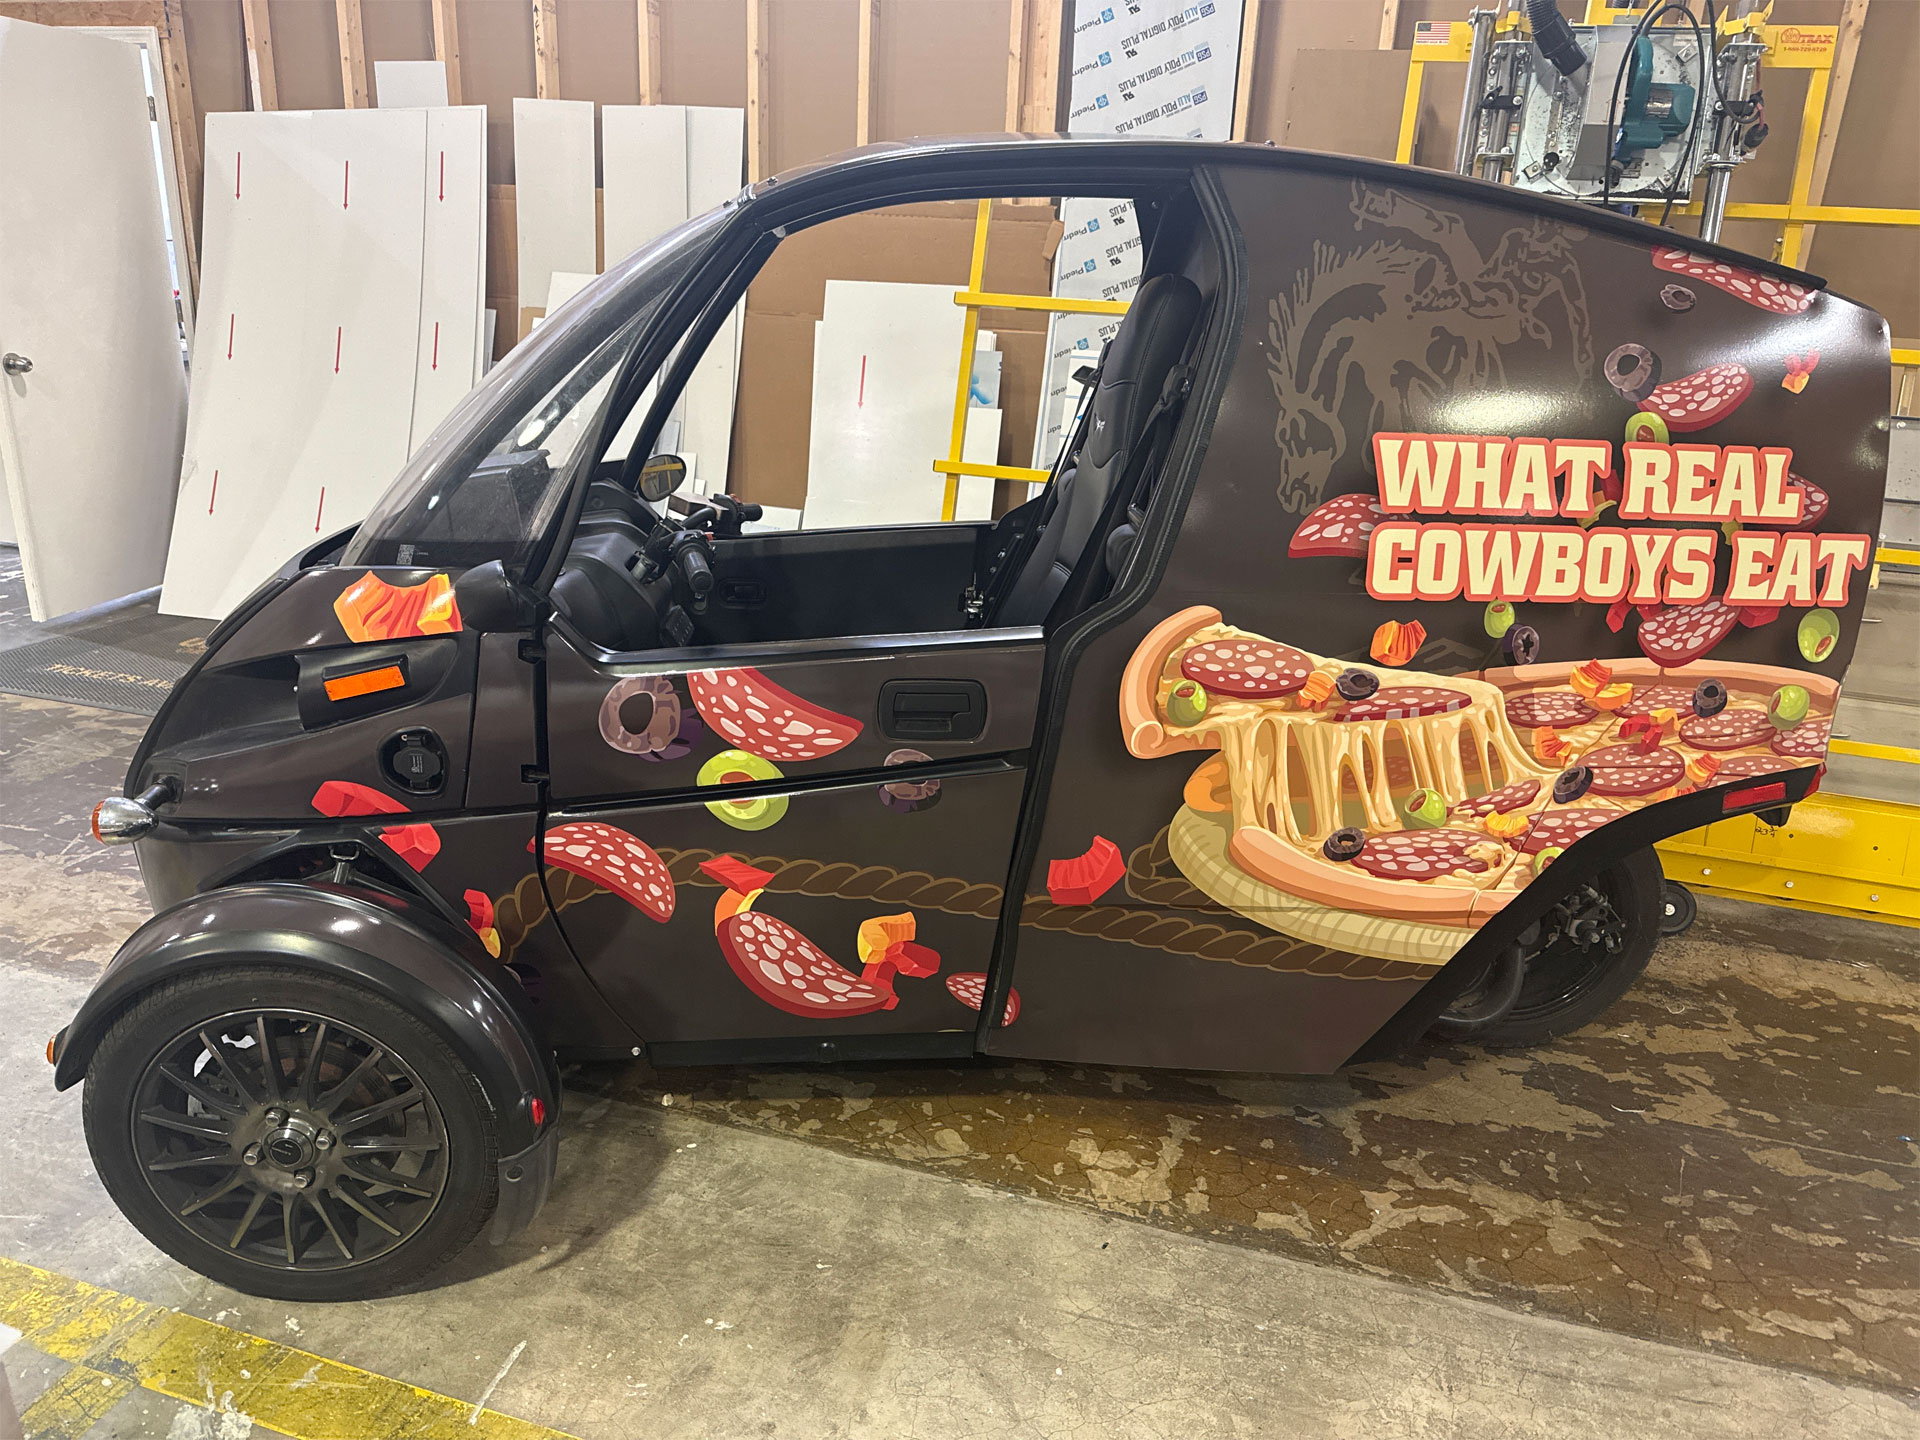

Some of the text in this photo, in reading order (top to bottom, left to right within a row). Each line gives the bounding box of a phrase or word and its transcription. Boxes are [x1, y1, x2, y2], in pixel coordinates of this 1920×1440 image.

[1185, 6, 1198, 19] ALU
[1167, 13, 1184, 29] POLY
[1139, 21, 1166, 40] DIGITAL
[1121, 34, 1139, 50] PLUS
[1181, 50, 1195, 63] ALU
[1164, 57, 1181, 73] POLY
[1136, 65, 1162, 83] DIGITAL
[1118, 77, 1137, 93] PLUS
[1178, 93, 1191, 106] ALU
[1161, 100, 1177, 116] POLY
[1133, 108, 1159, 125] DIGITAL
[1115, 121, 1134, 134] PLUS
[1109, 202, 1127, 218] PLUS
[1105, 244, 1123, 258] PLUS
[1102, 283, 1120, 298] PLUS
[1098, 322, 1116, 337] PLUS
[1373, 432, 1805, 525] WHAT REAL
[1366, 522, 1871, 607] COWBOYS EAT
